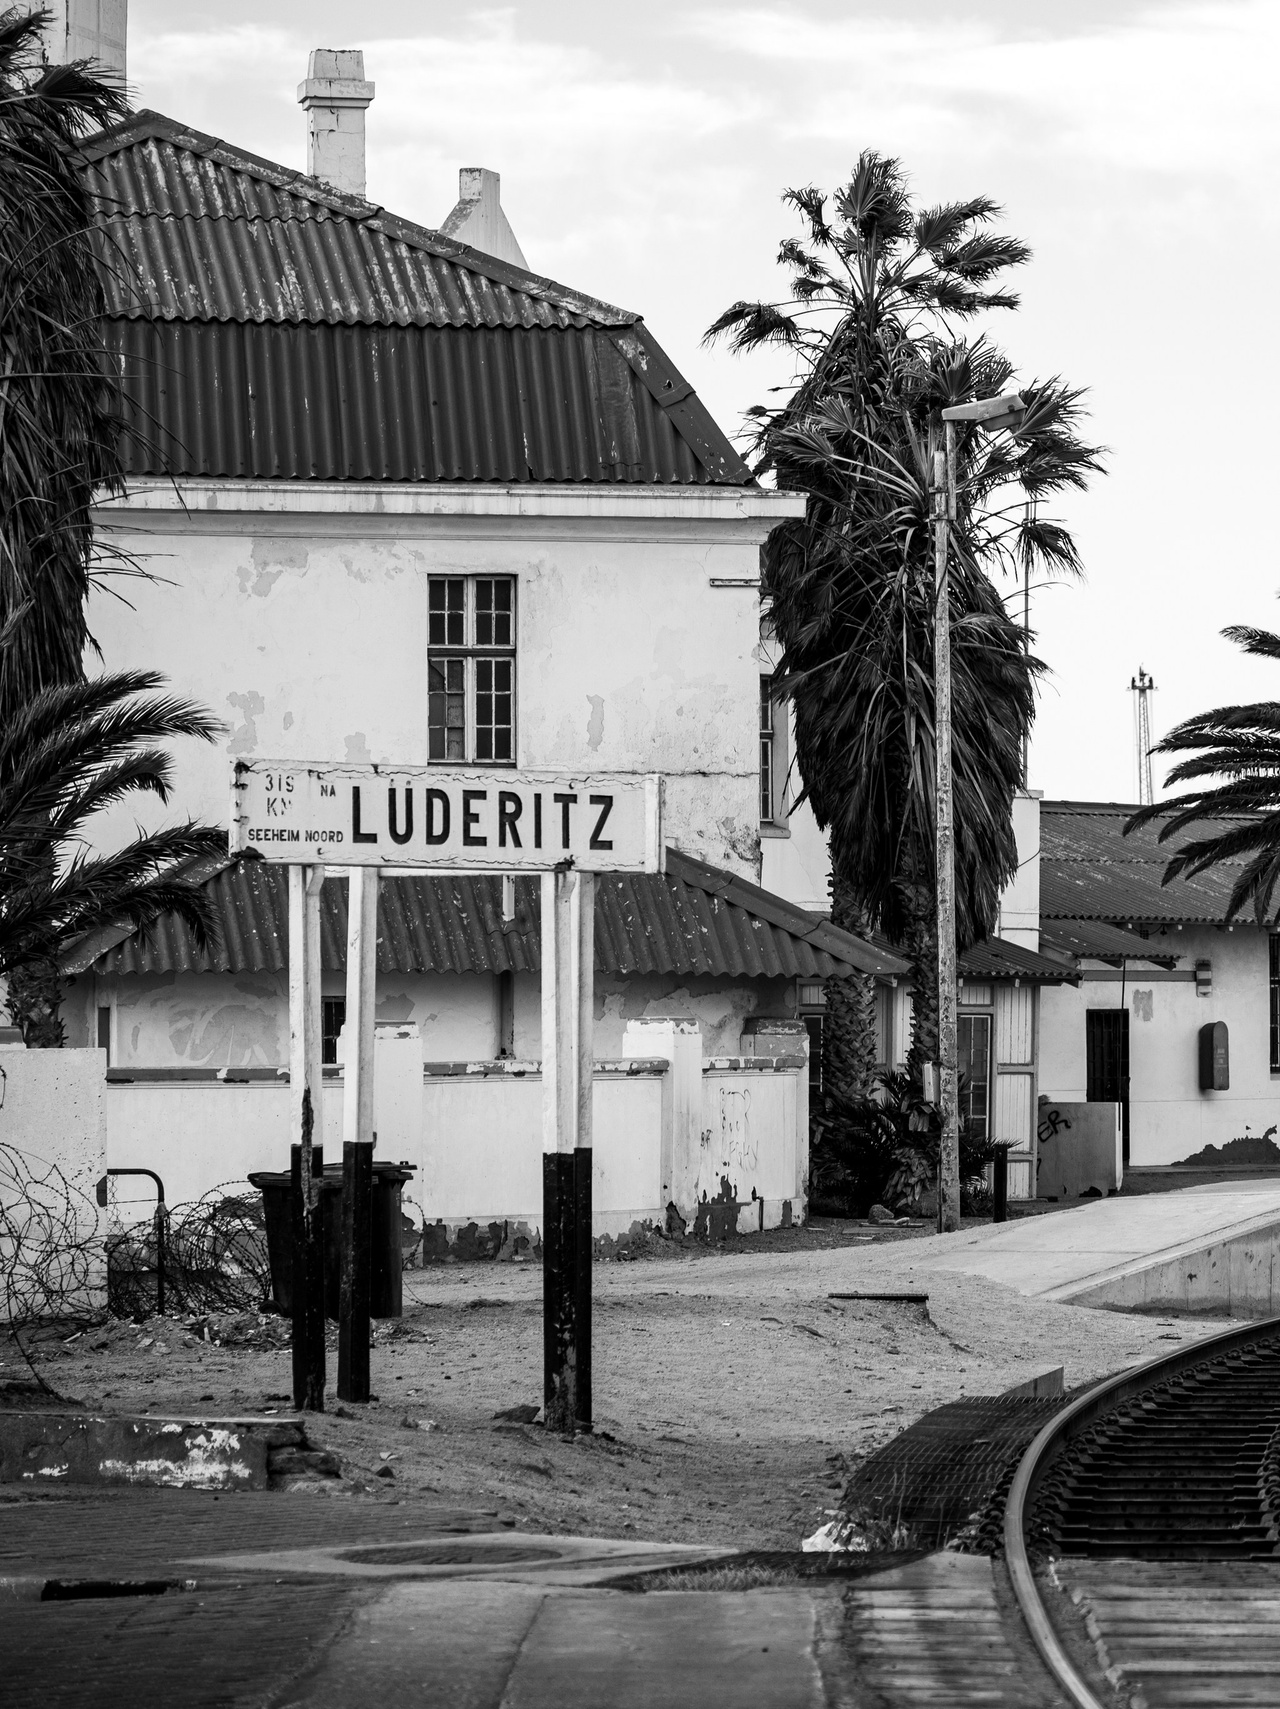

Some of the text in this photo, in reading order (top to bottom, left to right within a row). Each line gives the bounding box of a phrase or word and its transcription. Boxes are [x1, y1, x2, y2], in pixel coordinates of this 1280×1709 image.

[320, 784, 337, 798] NA
[247, 828, 345, 844] SEEHEIM NOORD
